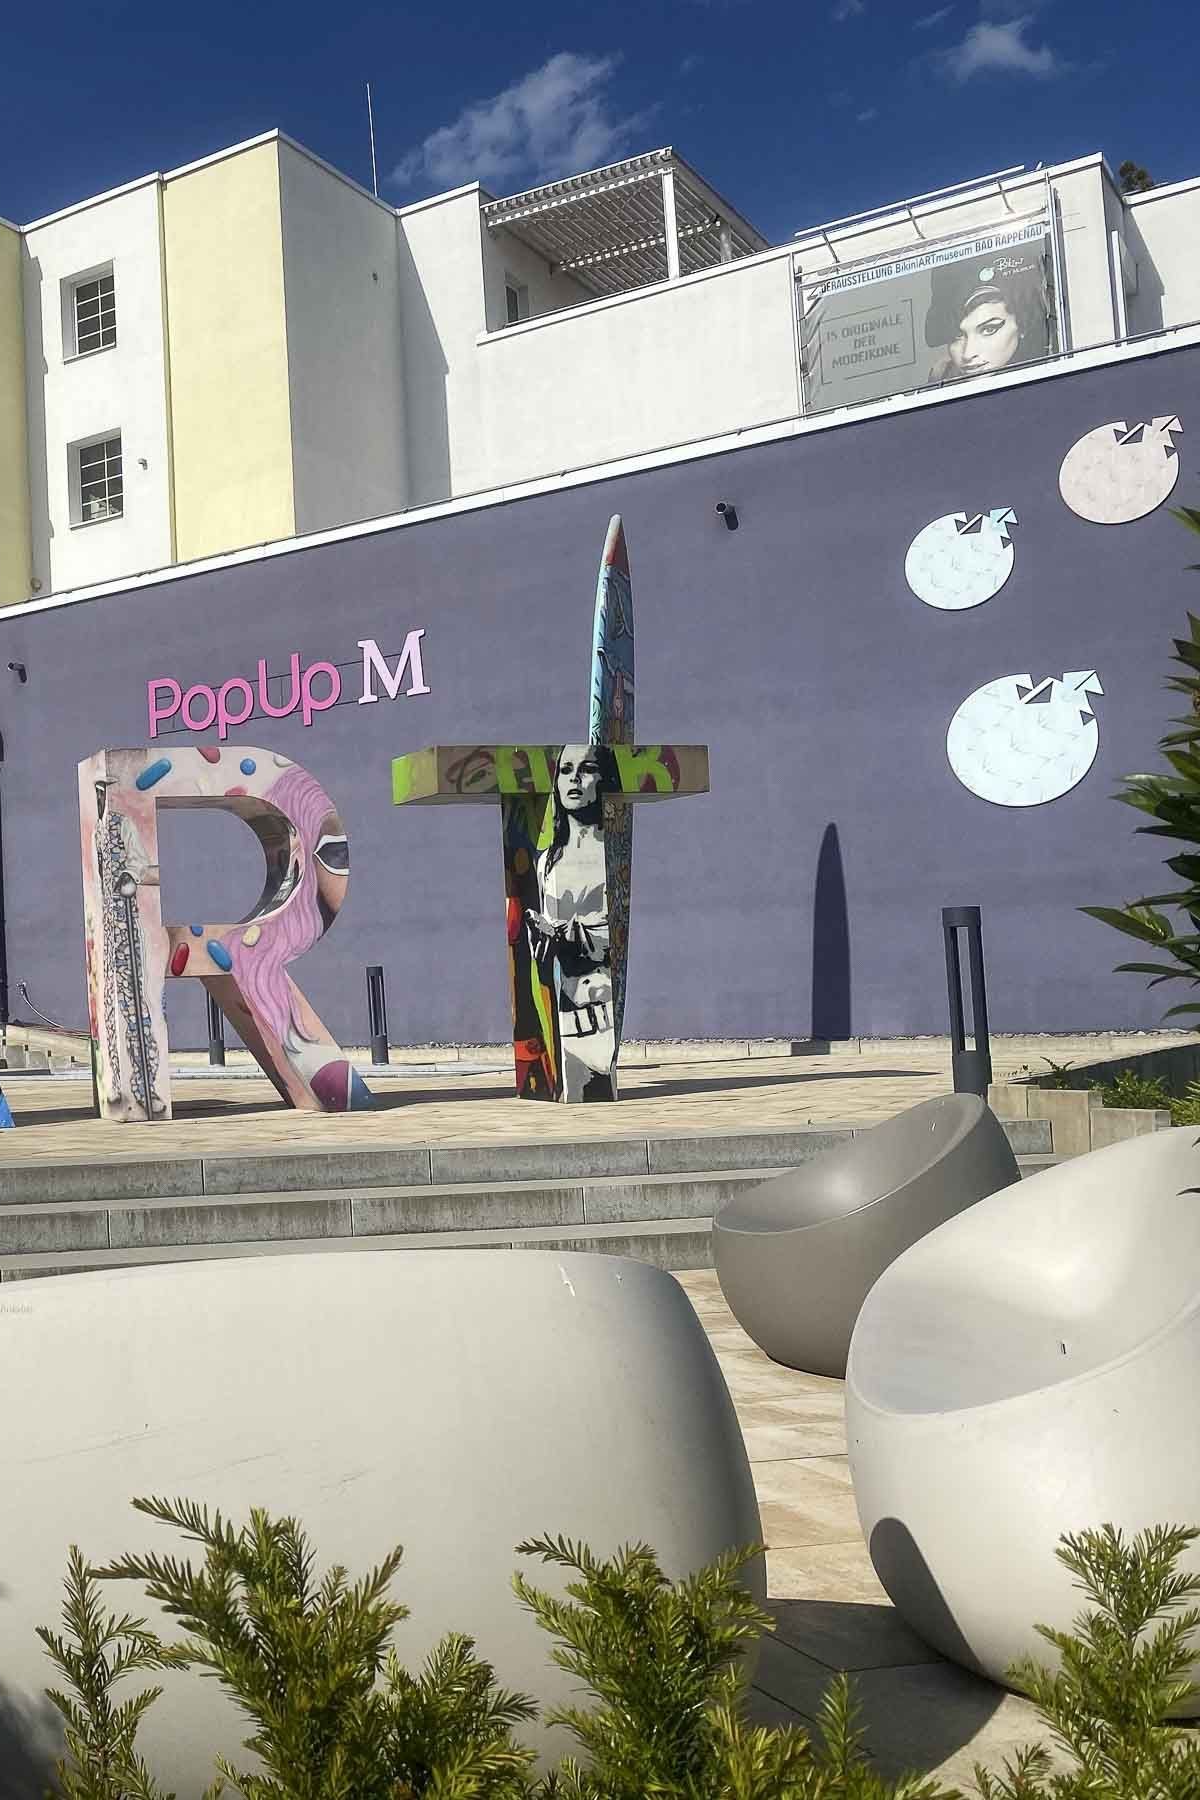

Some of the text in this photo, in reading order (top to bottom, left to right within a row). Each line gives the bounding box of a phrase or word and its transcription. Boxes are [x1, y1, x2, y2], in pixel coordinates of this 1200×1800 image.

[895, 247, 972, 273] BikiniARTmuseum
[975, 239, 993, 252] BAD
[995, 225, 1042, 247] RAPPENAU
[841, 313, 903, 338] ORIGINALE
[854, 334, 877, 349] DER
[832, 343, 901, 368] MODEIKONE
[147, 628, 431, 740] PopUp M
